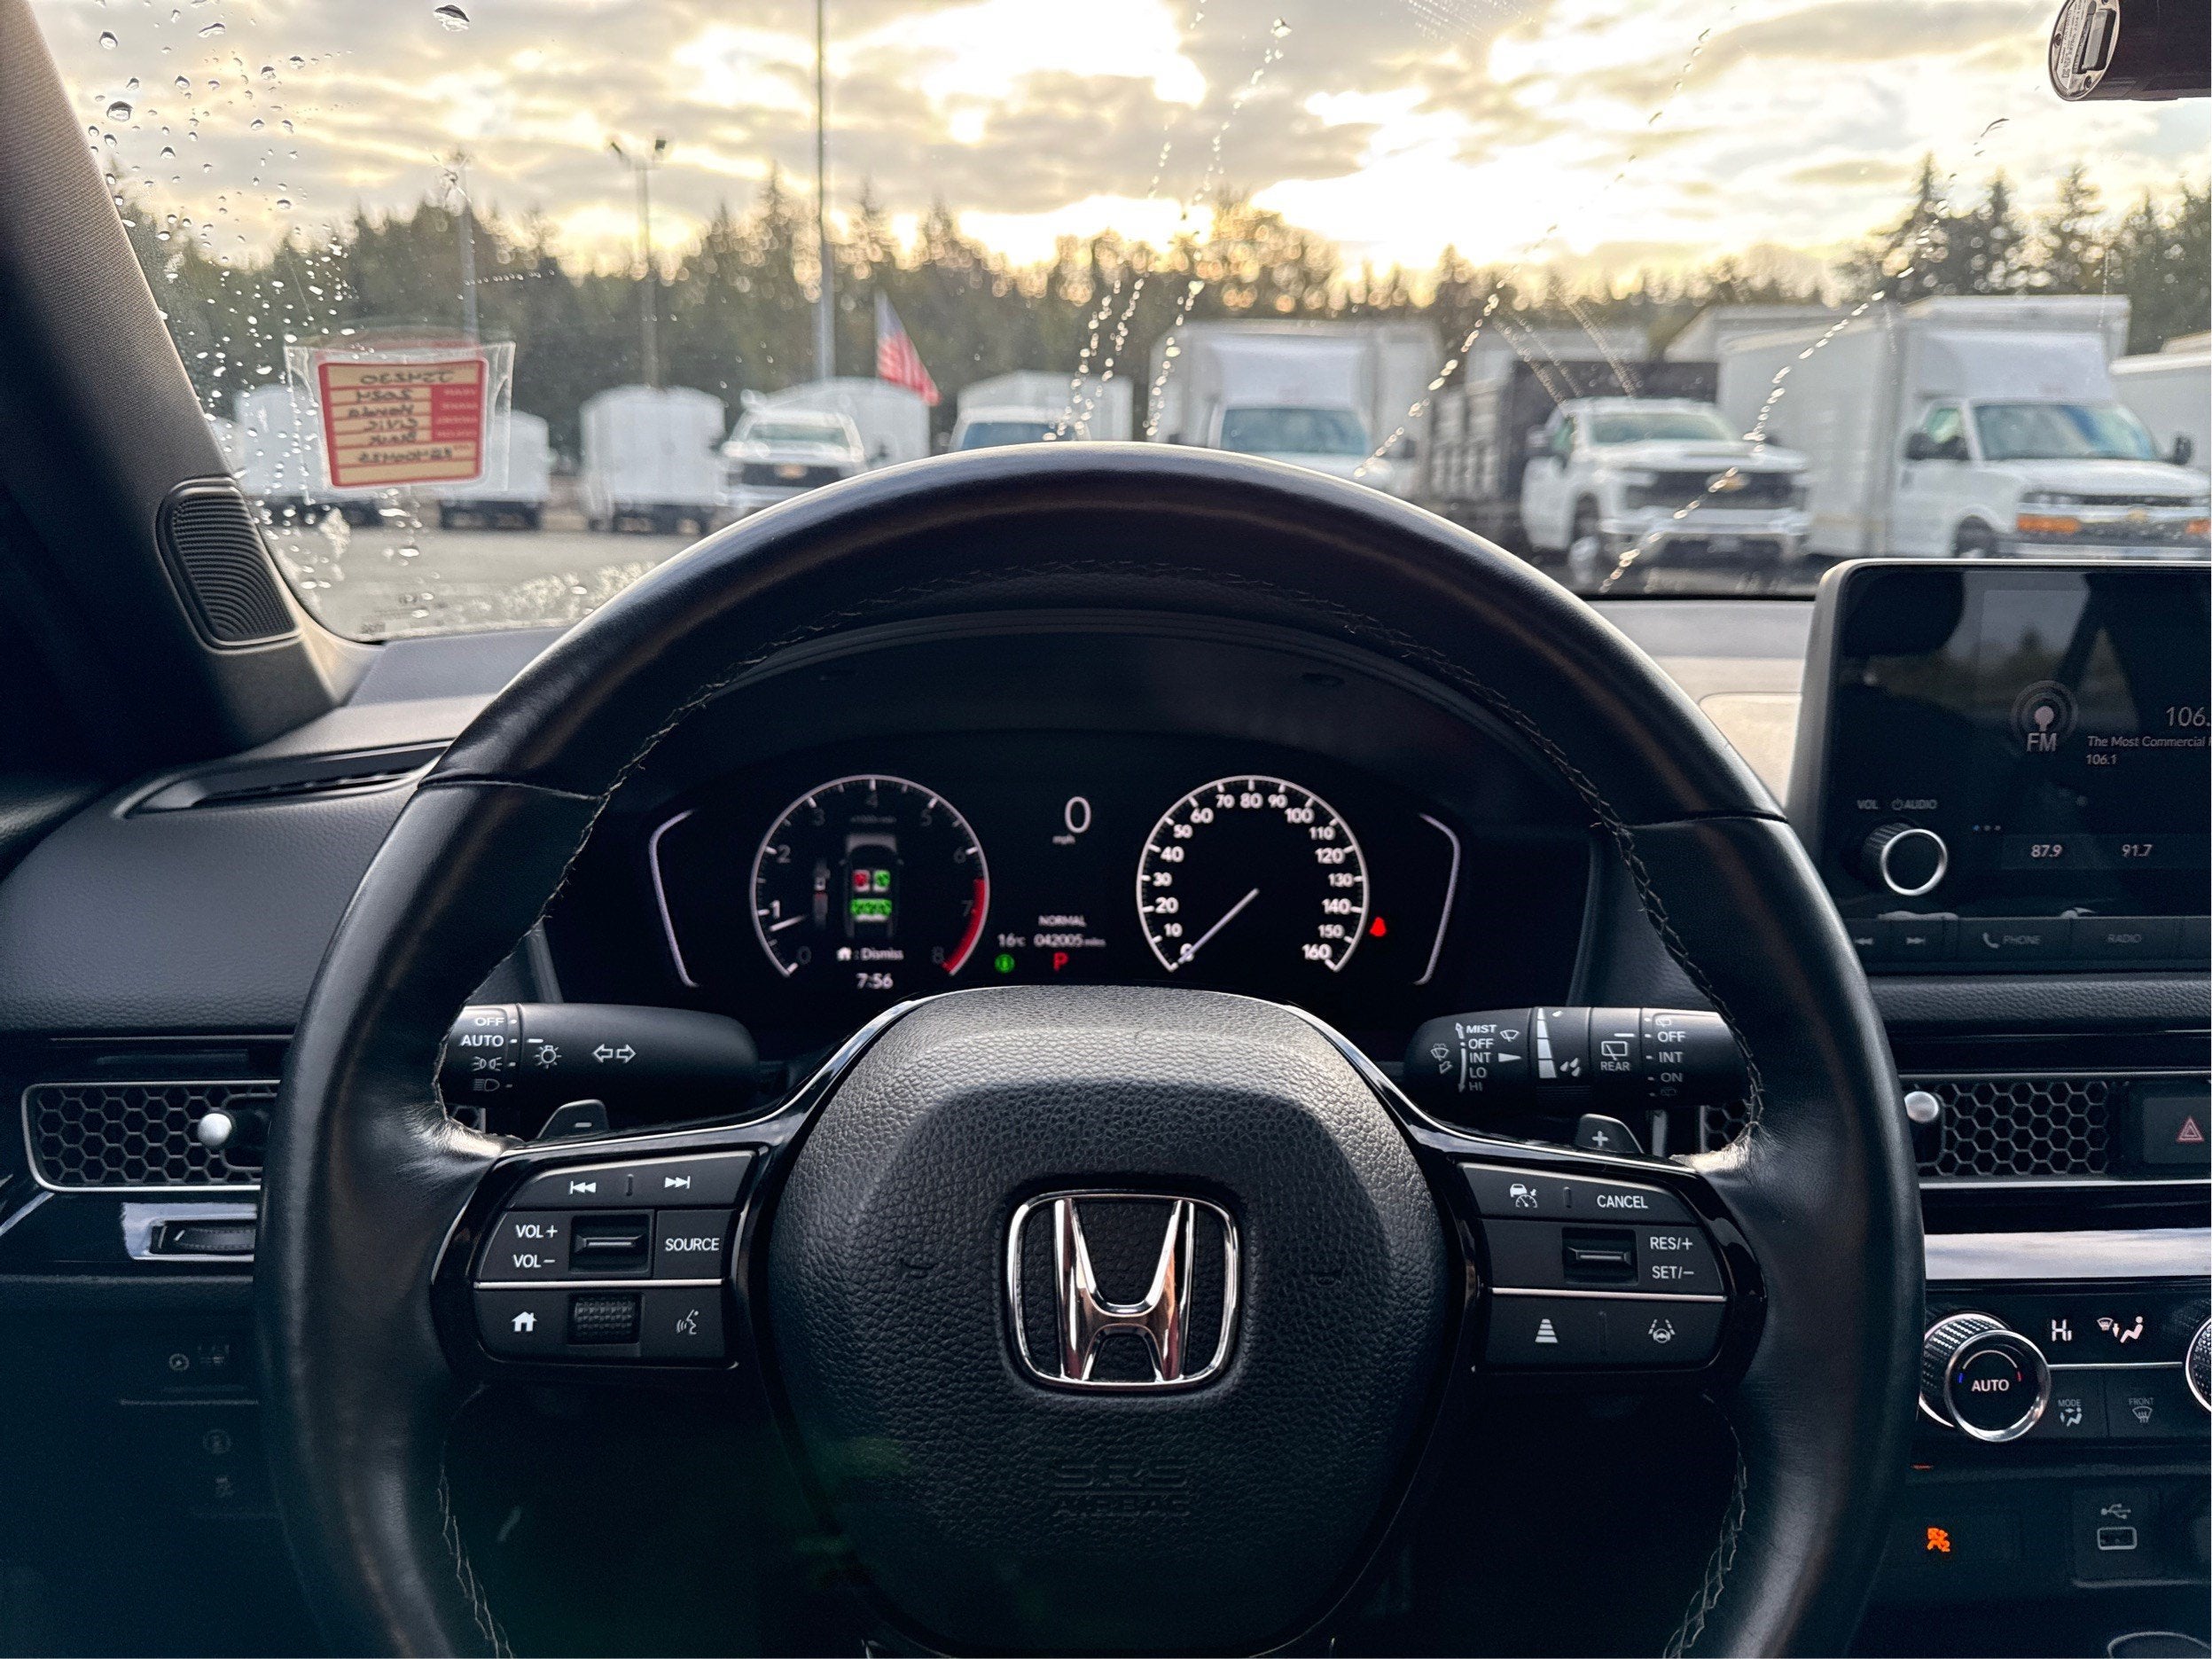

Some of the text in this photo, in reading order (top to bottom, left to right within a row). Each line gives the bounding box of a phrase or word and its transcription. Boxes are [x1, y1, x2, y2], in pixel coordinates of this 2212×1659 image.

[2027, 730, 2057, 751] FM
[2088, 736, 2108, 747] The
[2111, 736, 2138, 747] Most
[2142, 736, 2205, 747] Commercial
[2086, 754, 2116, 764] 106.1
[1215, 794, 1234, 808] 70
[1240, 793, 1262, 808] 80
[1268, 794, 1288, 808] 90
[1856, 799, 1937, 810] VOL AUDIO
[815, 808, 826, 826] 3
[920, 809, 932, 826] 5
[1065, 796, 1090, 833] 0
[1191, 806, 1214, 823] 60
[1284, 806, 1314, 823] 100
[1173, 825, 1192, 838] 50
[1309, 826, 1335, 840] 110
[776, 845, 792, 863] 2
[953, 848, 966, 865] 6
[1160, 846, 1184, 862] 40
[1314, 847, 1344, 865] 120
[2031, 844, 2152, 857] 87.9 91.7
[1153, 873, 1172, 886] 30
[1328, 873, 1353, 888] 130
[770, 900, 781, 919] 1
[1156, 897, 1178, 913] 20
[1321, 897, 1350, 916] 140
[1039, 915, 1085, 927] NORMAL
[1164, 923, 1182, 937] 10
[1318, 925, 1346, 939] 150
[1034, 934, 1083, 947] 042005
[2003, 935, 2040, 944] PHONE
[2106, 934, 2142, 943] RADIO
[797, 946, 811, 965] 0
[861, 948, 903, 960] Dismiss
[932, 946, 943, 965] 8
[1301, 943, 1333, 961] 160
[1054, 952, 1068, 970] P
[857, 973, 893, 989] 7:56
[475, 1017, 505, 1027] OFF
[1466, 1024, 1497, 1033] MIST
[460, 1035, 504, 1046] AUTO
[1656, 1029, 1686, 1042] OFF
[1468, 1038, 1494, 1049] OFF
[1470, 1053, 1491, 1062] INT
[1659, 1052, 1683, 1062] INT
[1600, 1059, 1630, 1071] REAR
[1469, 1067, 1487, 1078] LO
[1661, 1073, 1682, 1082] ON
[1469, 1082, 1482, 1091] HI
[1597, 1195, 1648, 1209] CANCEL
[666, 1238, 719, 1251] SOURCE
[1650, 1237, 1692, 1249] RES/+
[1972, 1380, 2009, 1391] AUTO
[2058, 1399, 2081, 1408] MODE
[2129, 1397, 2153, 1406] FRONT
